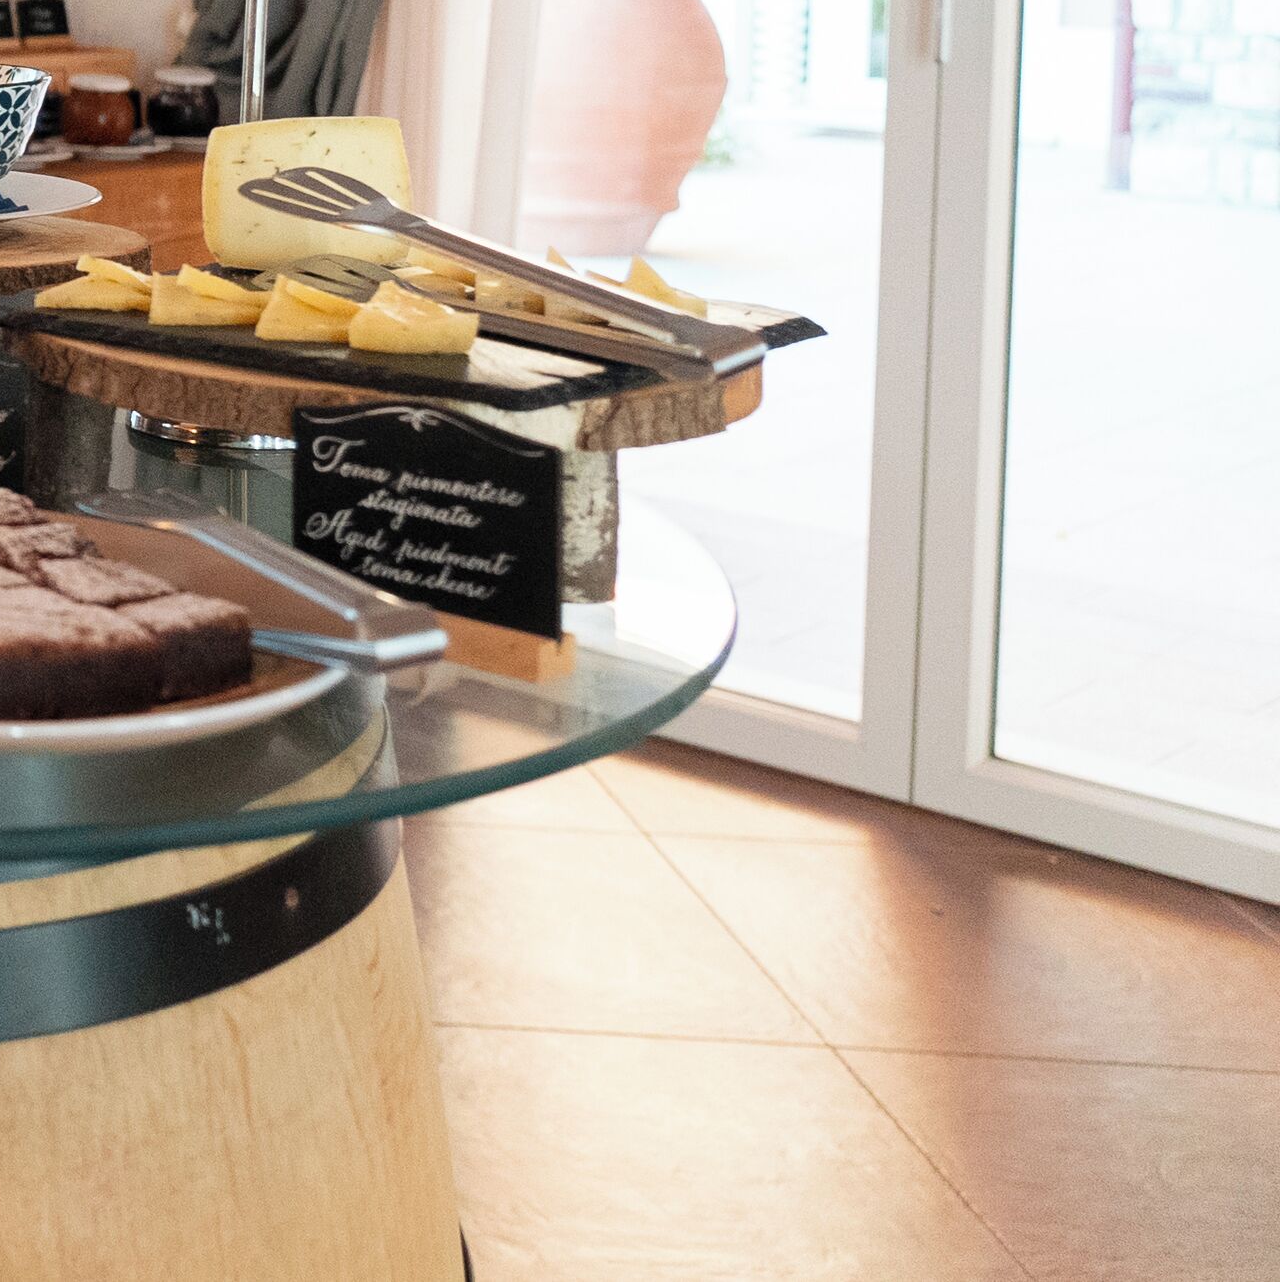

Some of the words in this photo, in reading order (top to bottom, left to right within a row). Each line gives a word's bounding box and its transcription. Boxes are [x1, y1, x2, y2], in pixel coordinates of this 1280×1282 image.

[312, 435, 390, 483] Toma
[393, 470, 525, 507] piemontese
[357, 488, 481, 536] stagionata
[303, 508, 387, 560] Aged
[393, 537, 516, 576] piedmont
[419, 565, 496, 600] cheese
